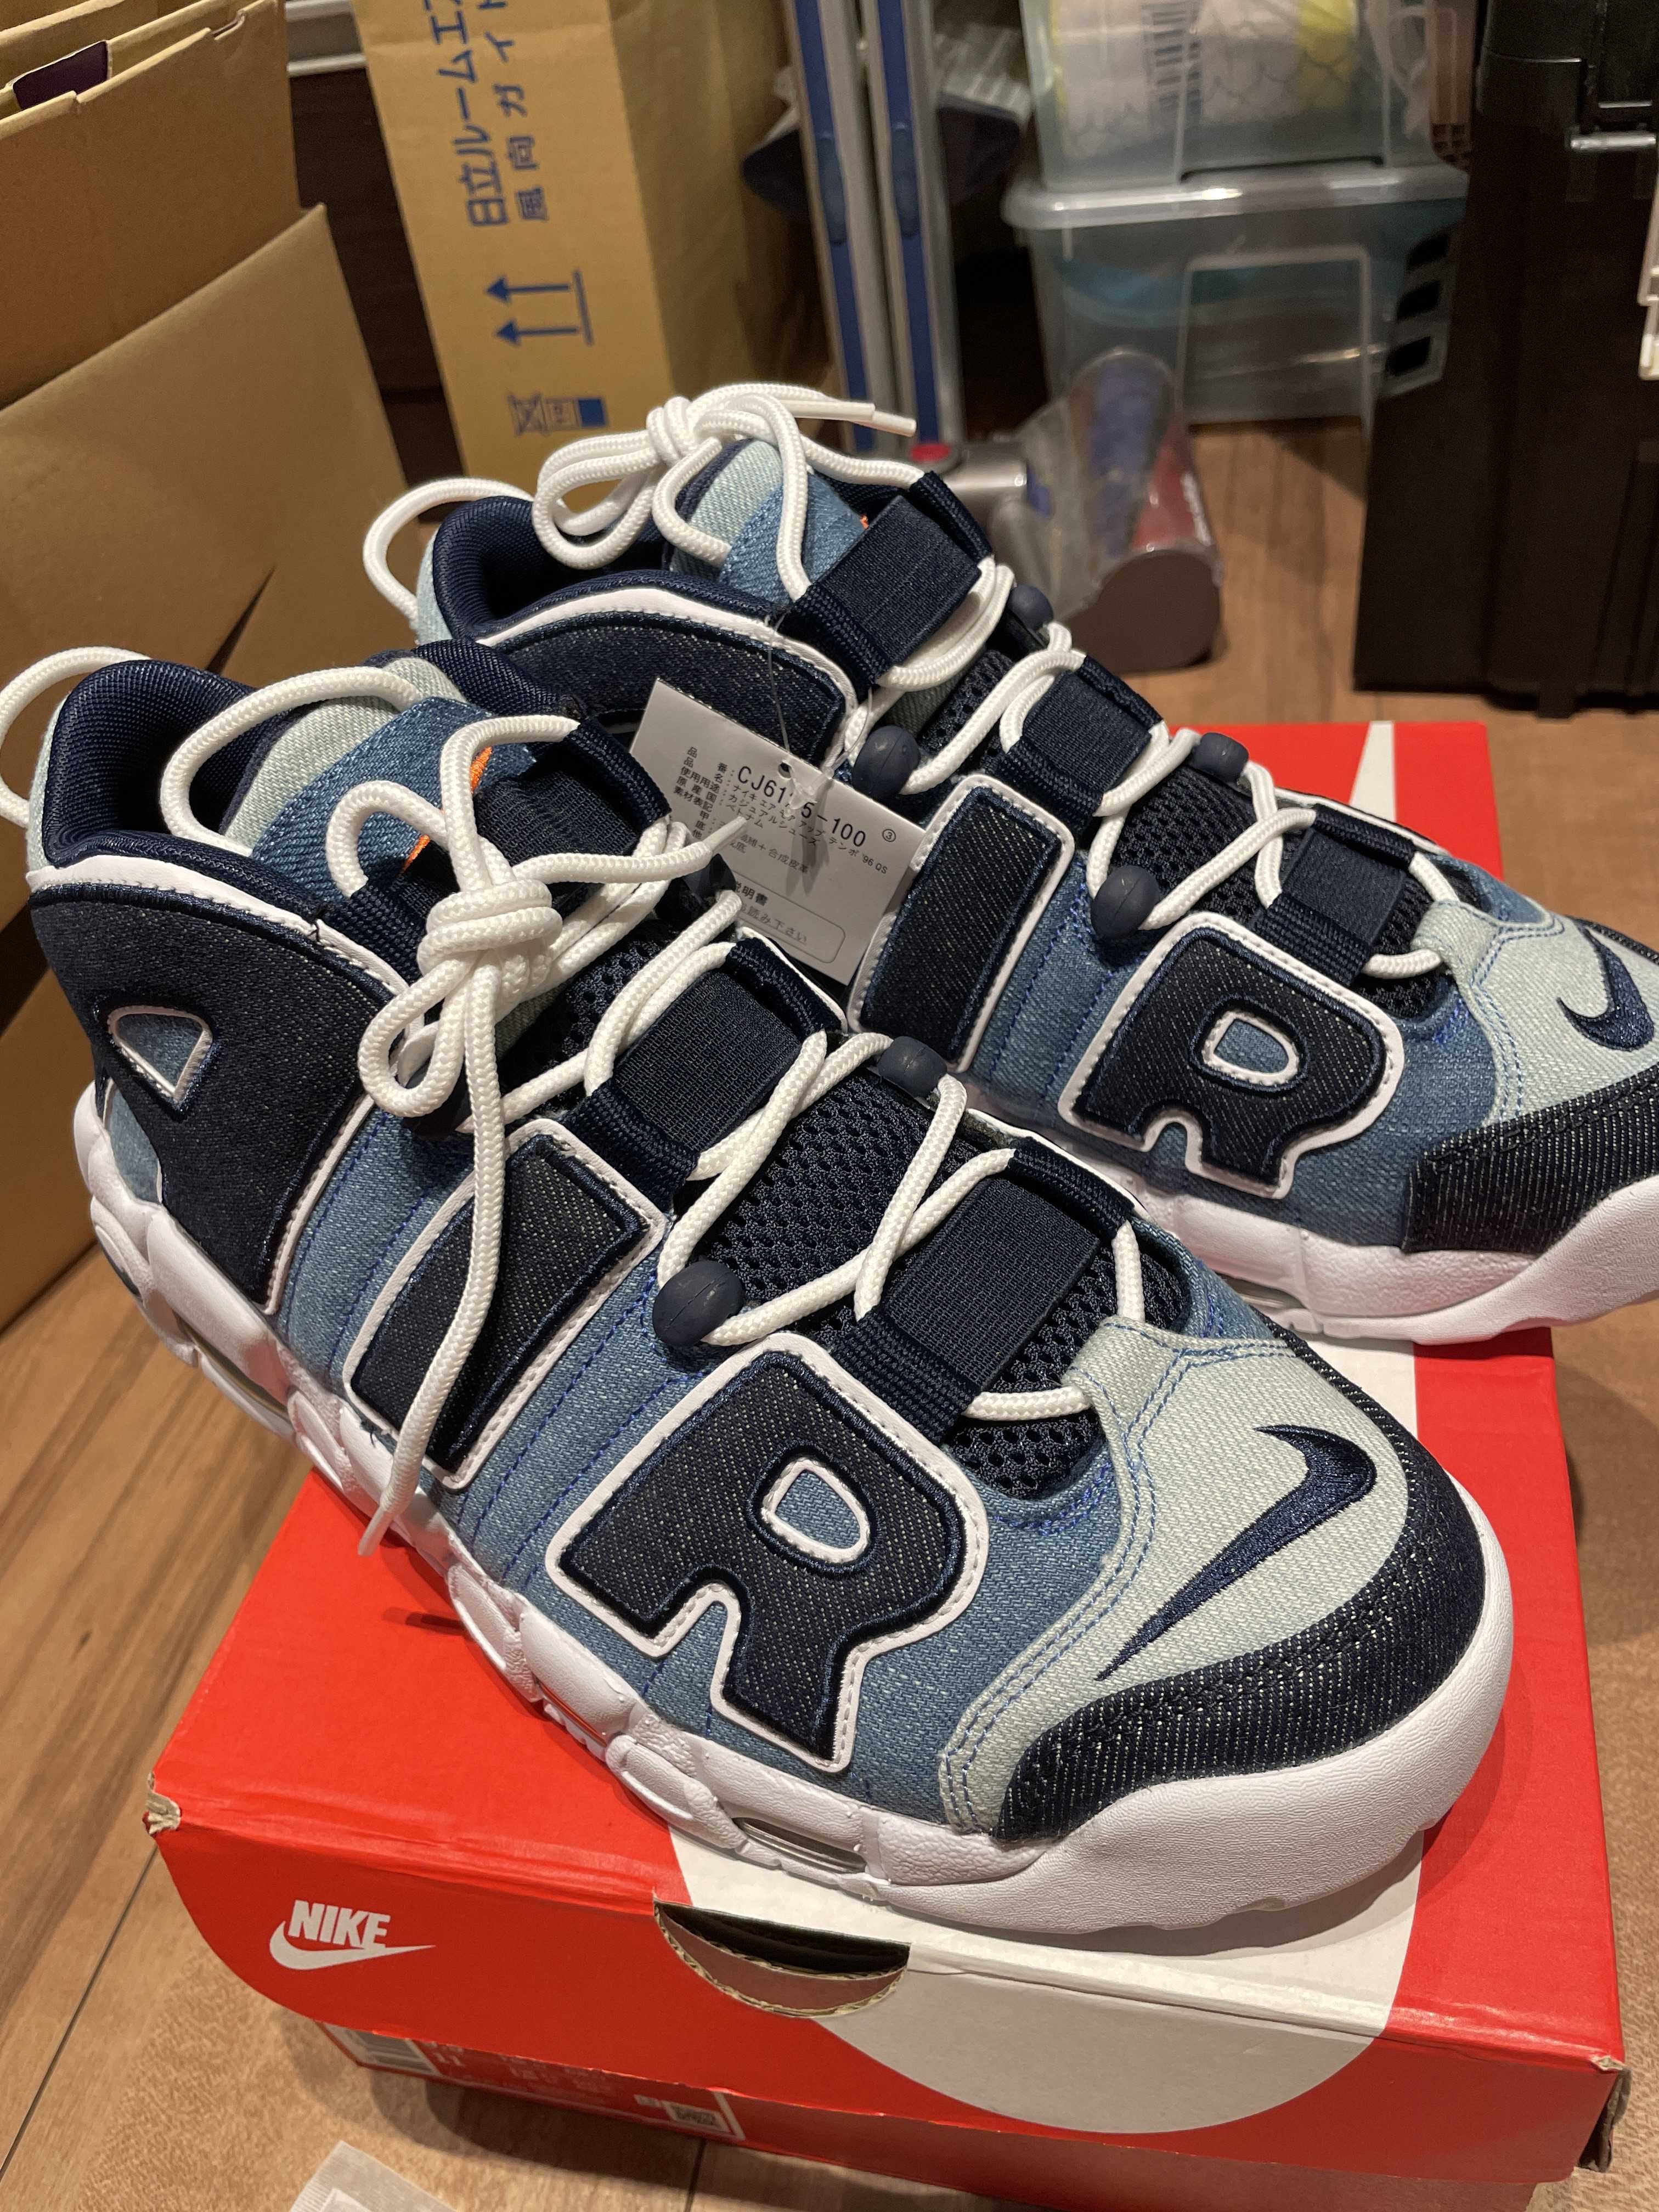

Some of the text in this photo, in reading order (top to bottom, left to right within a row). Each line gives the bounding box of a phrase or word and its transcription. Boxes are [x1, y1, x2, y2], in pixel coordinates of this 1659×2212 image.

[424, 0, 509, 225] 日立ルームエ
[735, 764, 868, 848] CJ615-100
[287, 1899, 391, 1949] NIKE
